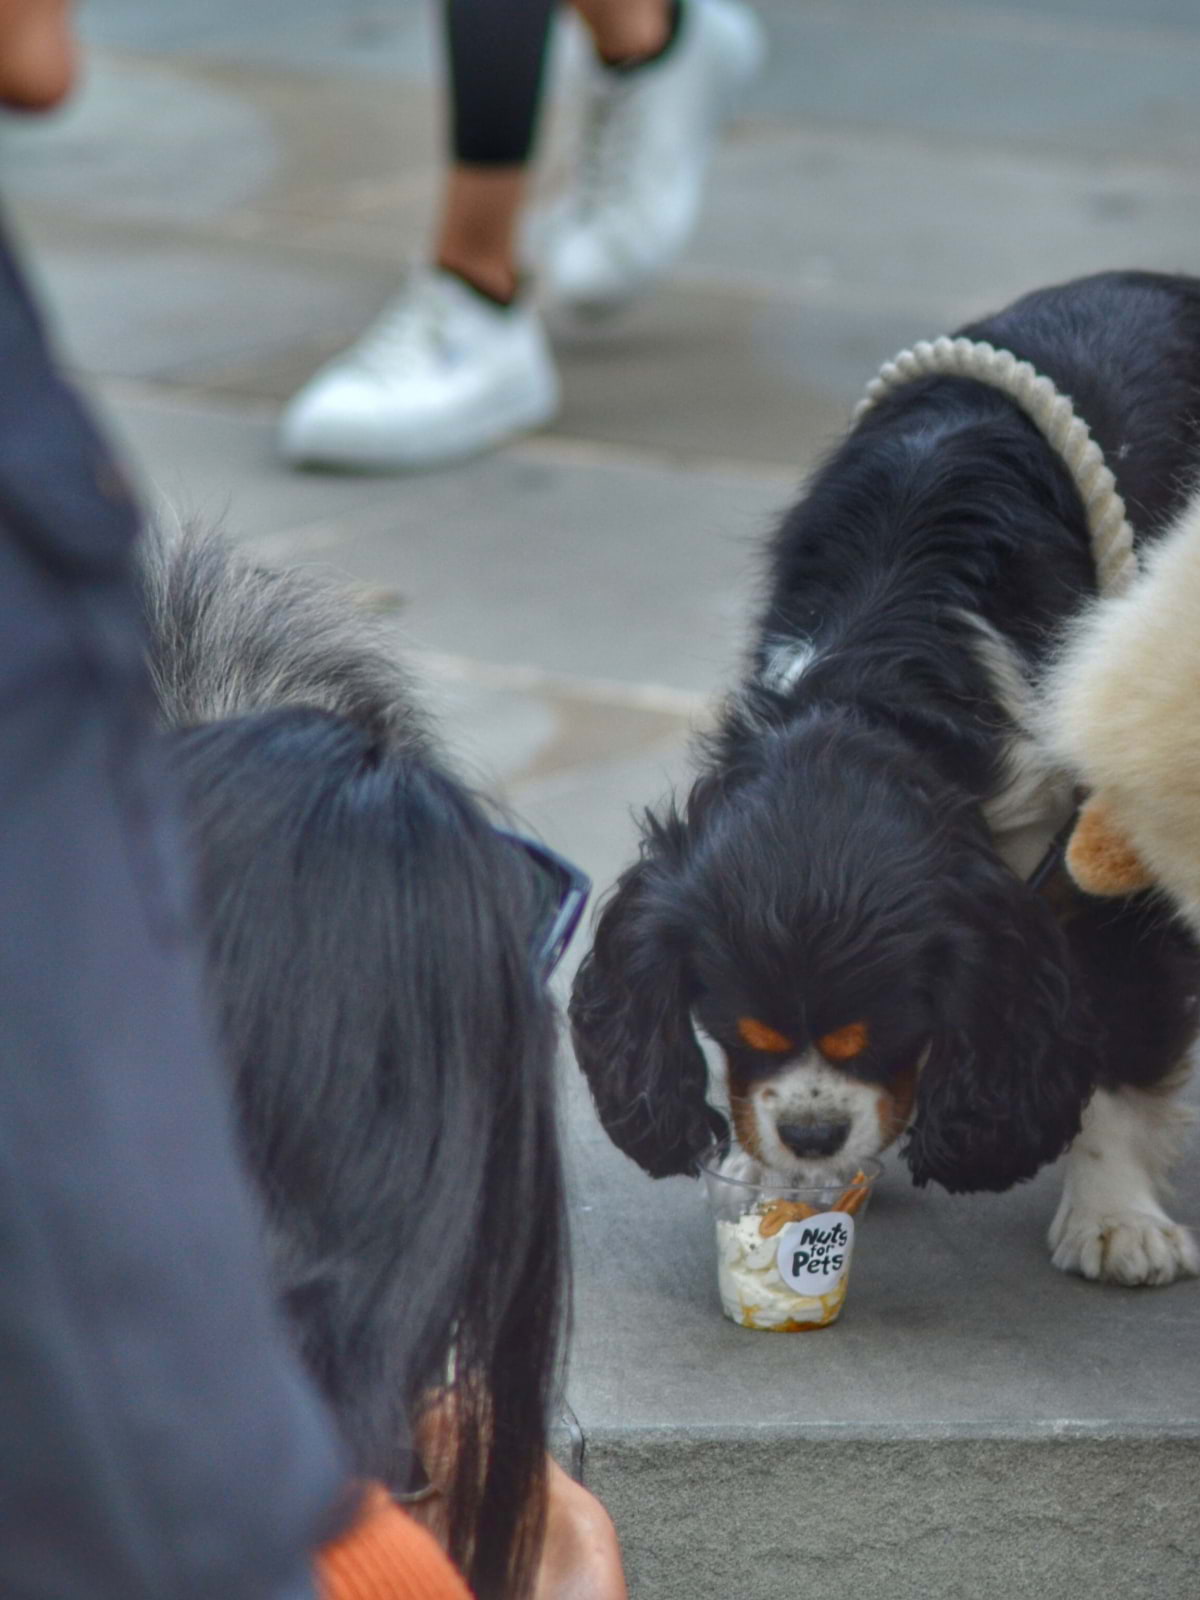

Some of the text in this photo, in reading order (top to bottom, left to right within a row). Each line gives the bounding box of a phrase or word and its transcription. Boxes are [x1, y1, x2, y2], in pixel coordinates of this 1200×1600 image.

[800, 1222, 848, 1247] Nuts
[810, 1244, 835, 1258] for
[792, 1251, 844, 1277] Pets
